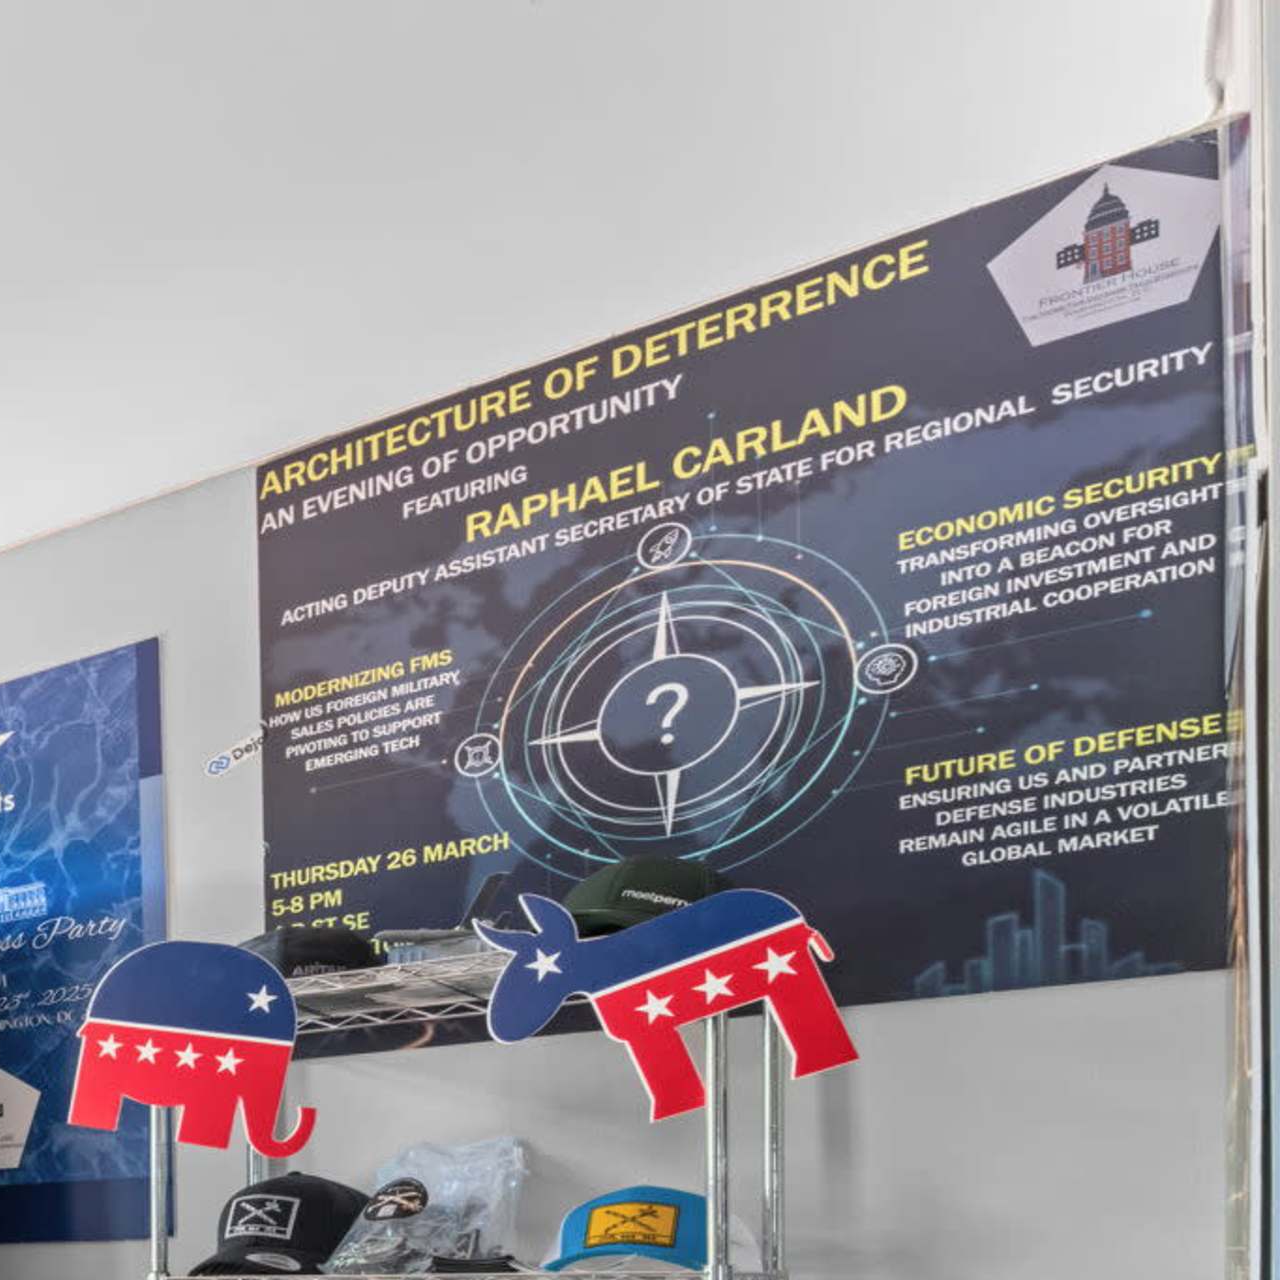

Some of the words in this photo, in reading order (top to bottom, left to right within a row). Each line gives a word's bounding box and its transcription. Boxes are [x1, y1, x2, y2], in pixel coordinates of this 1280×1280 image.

[259, 380, 534, 500] ARCHITECTURE
[544, 356, 600, 401] OF
[611, 239, 932, 380] DETERRENCE
[260, 509, 297, 536] AN
[301, 466, 415, 522] EVENING
[421, 445, 459, 479] OF
[465, 374, 684, 466] OPPORTUNITY
[280, 593, 348, 627] ACTING
[353, 568, 430, 605] DEPUTY
[434, 533, 550, 582] ASSISTANT
[554, 493, 691, 547] SECRETARY
[696, 476, 732, 508] OF
[735, 456, 814, 496] STATE
[820, 441, 876, 472] FOR
[883, 395, 1037, 456] REGIONAL
[1050, 342, 1216, 406] SECURITY
[465, 460, 662, 544] RAPHAEL
[671, 382, 909, 482] CARLAND
[402, 465, 529, 520] FEATURING
[897, 494, 1057, 552] ECONOMIC
[1062, 451, 1223, 511] SECURITY
[896, 518, 1077, 575] TRANSFORMING
[1083, 481, 1227, 530] OVERSIGHT
[268, 711, 302, 728] HOW
[304, 705, 323, 720] US
[326, 691, 388, 714] FOREIGN
[274, 661, 405, 708] MODERNIZING
[409, 649, 454, 675] FMS
[290, 721, 334, 740] SALES
[336, 705, 401, 730] POLICIES
[404, 694, 436, 712] ARE
[904, 748, 1017, 786] FUTURE
[1023, 740, 1066, 767] OF
[1073, 713, 1223, 759] DEFENSE
[271, 855, 382, 890] THURSDAY
[386, 848, 417, 871] 26
[422, 831, 511, 864] MARCH
[32, 914, 128, 951] Party
[271, 896, 304, 917] 5-8
[309, 889, 343, 910] PM
